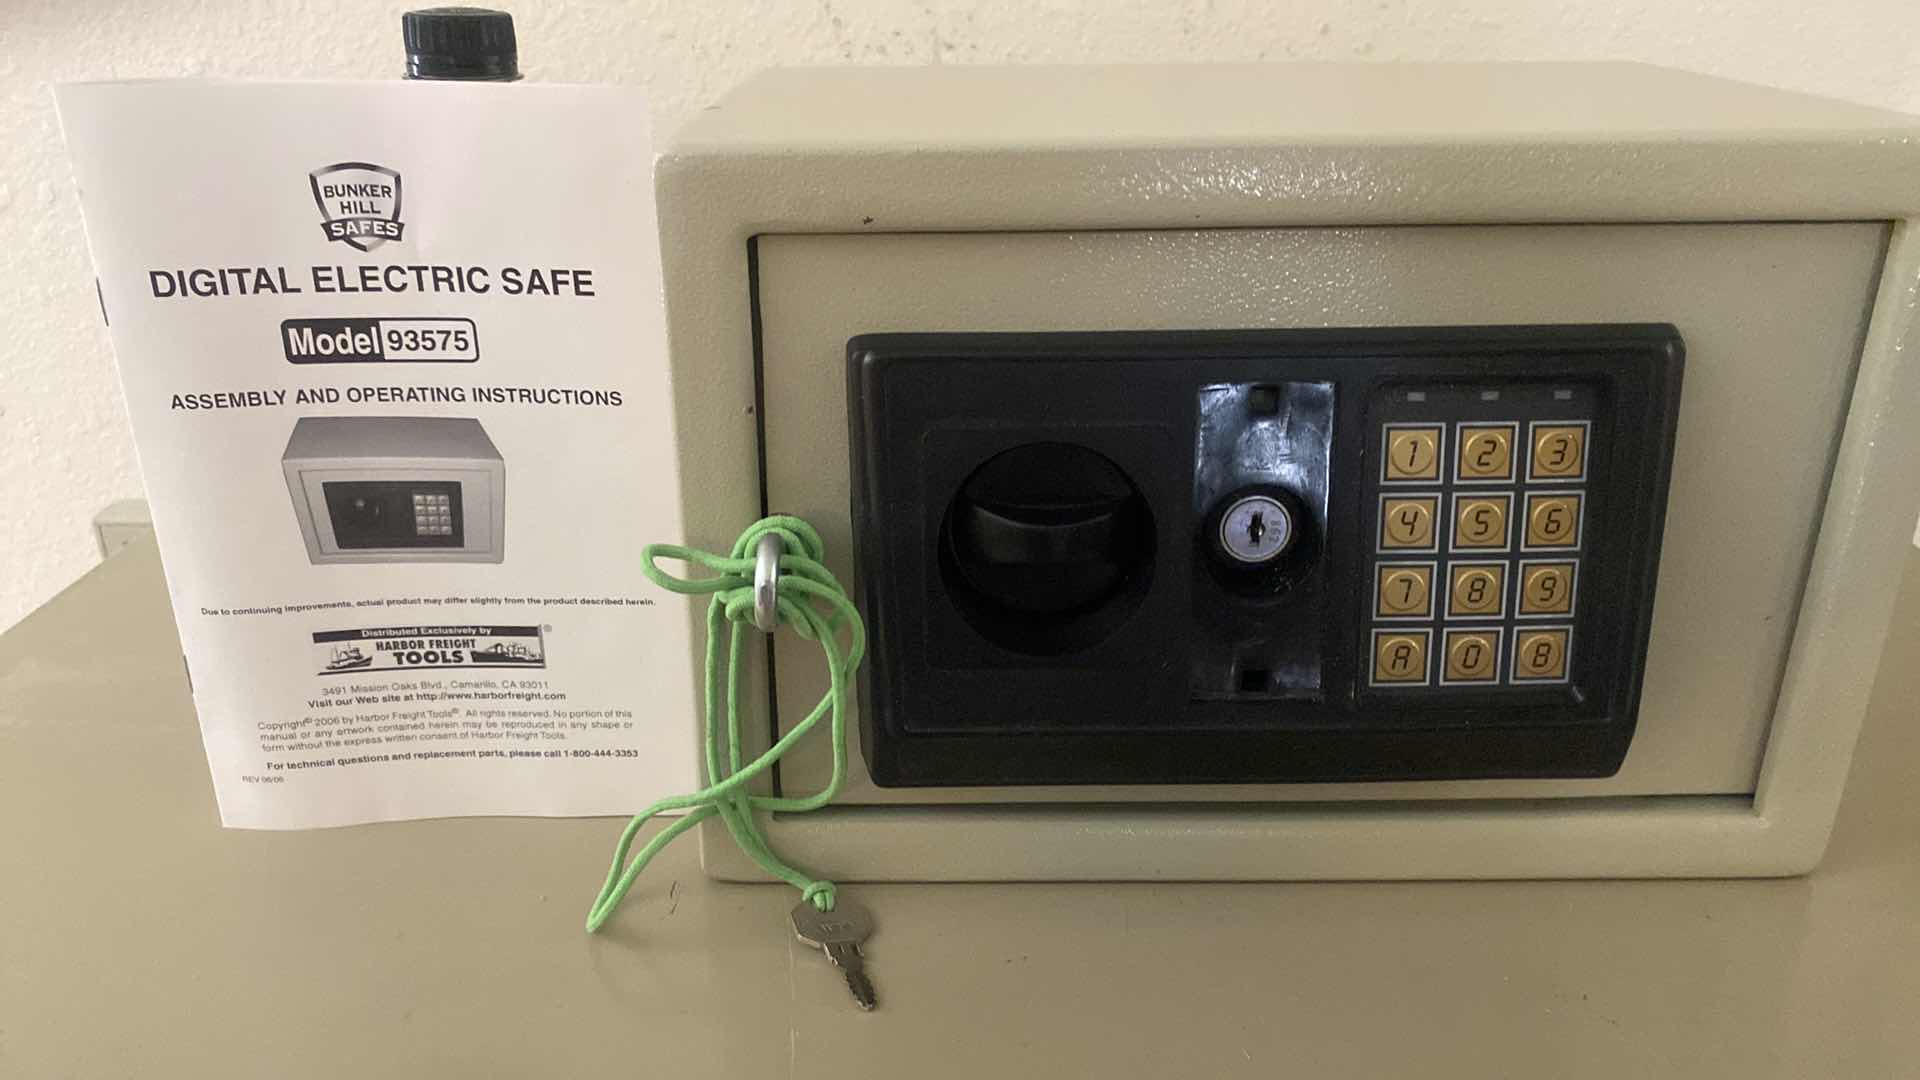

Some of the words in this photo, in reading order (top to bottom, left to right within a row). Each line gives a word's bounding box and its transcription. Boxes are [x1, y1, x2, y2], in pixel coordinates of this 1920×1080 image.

[323, 184, 392, 198] BUNKER
[340, 201, 382, 214] HILL
[331, 221, 399, 236] SAFES
[149, 267, 301, 298] DIGITAL
[312, 265, 491, 294] ELECTRIC
[502, 269, 595, 296] SAFE
[288, 327, 381, 357] Model
[387, 328, 470, 352] 93575
[171, 389, 287, 410] ASSEMBLY
[295, 388, 340, 404] AND
[346, 387, 466, 404] OPERATING
[472, 387, 623, 406] INSTRUCTIONS
[1409, 441, 1420, 466] 1
[1476, 440, 1496, 466] 2
[1550, 438, 1570, 465] 3
[1401, 511, 1417, 536] 4
[1474, 511, 1489, 536] 5
[1545, 508, 1562, 534] 6
[1400, 580, 1414, 603] 7
[1468, 578, 1486, 603] 8
[1540, 576, 1557, 601] 9
[201, 607, 219, 616] Due
[221, 608, 231, 616] to
[232, 605, 283, 615] continuing
[284, 600, 355, 613] improvements,
[356, 598, 384, 607] actual
[386, 597, 424, 607] product
[423, 598, 442, 606] may
[444, 596, 468, 605] differ
[470, 596, 502, 606] slightly
[504, 597, 526, 605] from
[527, 597, 541, 605] the
[543, 597, 578, 607] product
[580, 598, 624, 606] described
[625, 598, 656, 607] herein.
[361, 628, 418, 638] Distributed
[420, 627, 478, 638] Exclusively
[479, 627, 492, 636] by
[376, 641, 425, 651] HARBOR
[429, 639, 476, 650] FREIGHT
[393, 651, 464, 665] TOOLS
[1392, 648, 1411, 671] A
[1463, 646, 1480, 670] 0
[322, 686, 347, 696] 3491
[350, 683, 388, 693] Mission
[391, 681, 418, 691] Oaks
[502, 679, 517, 689] CA
[519, 680, 549, 688] 93011
[308, 700, 332, 709] Visit
[355, 696, 379, 705] Web
[381, 695, 402, 703] site
[404, 694, 415, 702] at
[416, 691, 566, 703] http://www.harborfreight.com
[315, 717, 340, 727] 2006
[342, 716, 354, 727] by
[356, 713, 390, 724] Harbor
[392, 710, 426, 721] Freight
[466, 709, 478, 718] All
[480, 709, 506, 719] rights
[508, 708, 550, 718] reserved.
[553, 708, 567, 718] No
[569, 708, 602, 720] portion
[604, 708, 615, 718] of
[615, 709, 632, 718] this
[260, 733, 297, 742] manual
[301, 731, 311, 740] or
[314, 730, 333, 740] any
[336, 726, 374, 736] artwork
[377, 723, 426, 734] contained
[428, 720, 459, 730] herein
[462, 719, 482, 729] may
[486, 717, 498, 729] be
[501, 718, 554, 730] reproduced
[558, 718, 567, 729] in
[570, 719, 588, 730] any
[591, 718, 621, 730] shape
[623, 720, 632, 729] or
[262, 743, 285, 752] form
[287, 740, 323, 752] without
[325, 738, 341, 748] the
[344, 736, 382, 747] express
[385, 733, 418, 743] written
[419, 730, 458, 742] consent
[459, 729, 470, 739] of
[471, 729, 504, 739] Harbor
[506, 729, 538, 740] Freight
[267, 762, 284, 770] For
[287, 757, 336, 769] technical
[337, 752, 389, 766] questions
[391, 750, 412, 761] and
[413, 747, 477, 759] replacement
[478, 748, 507, 759] parts,
[509, 749, 542, 759] please
[544, 750, 562, 758] call
[564, 750, 639, 758] 1-800-444-3353
